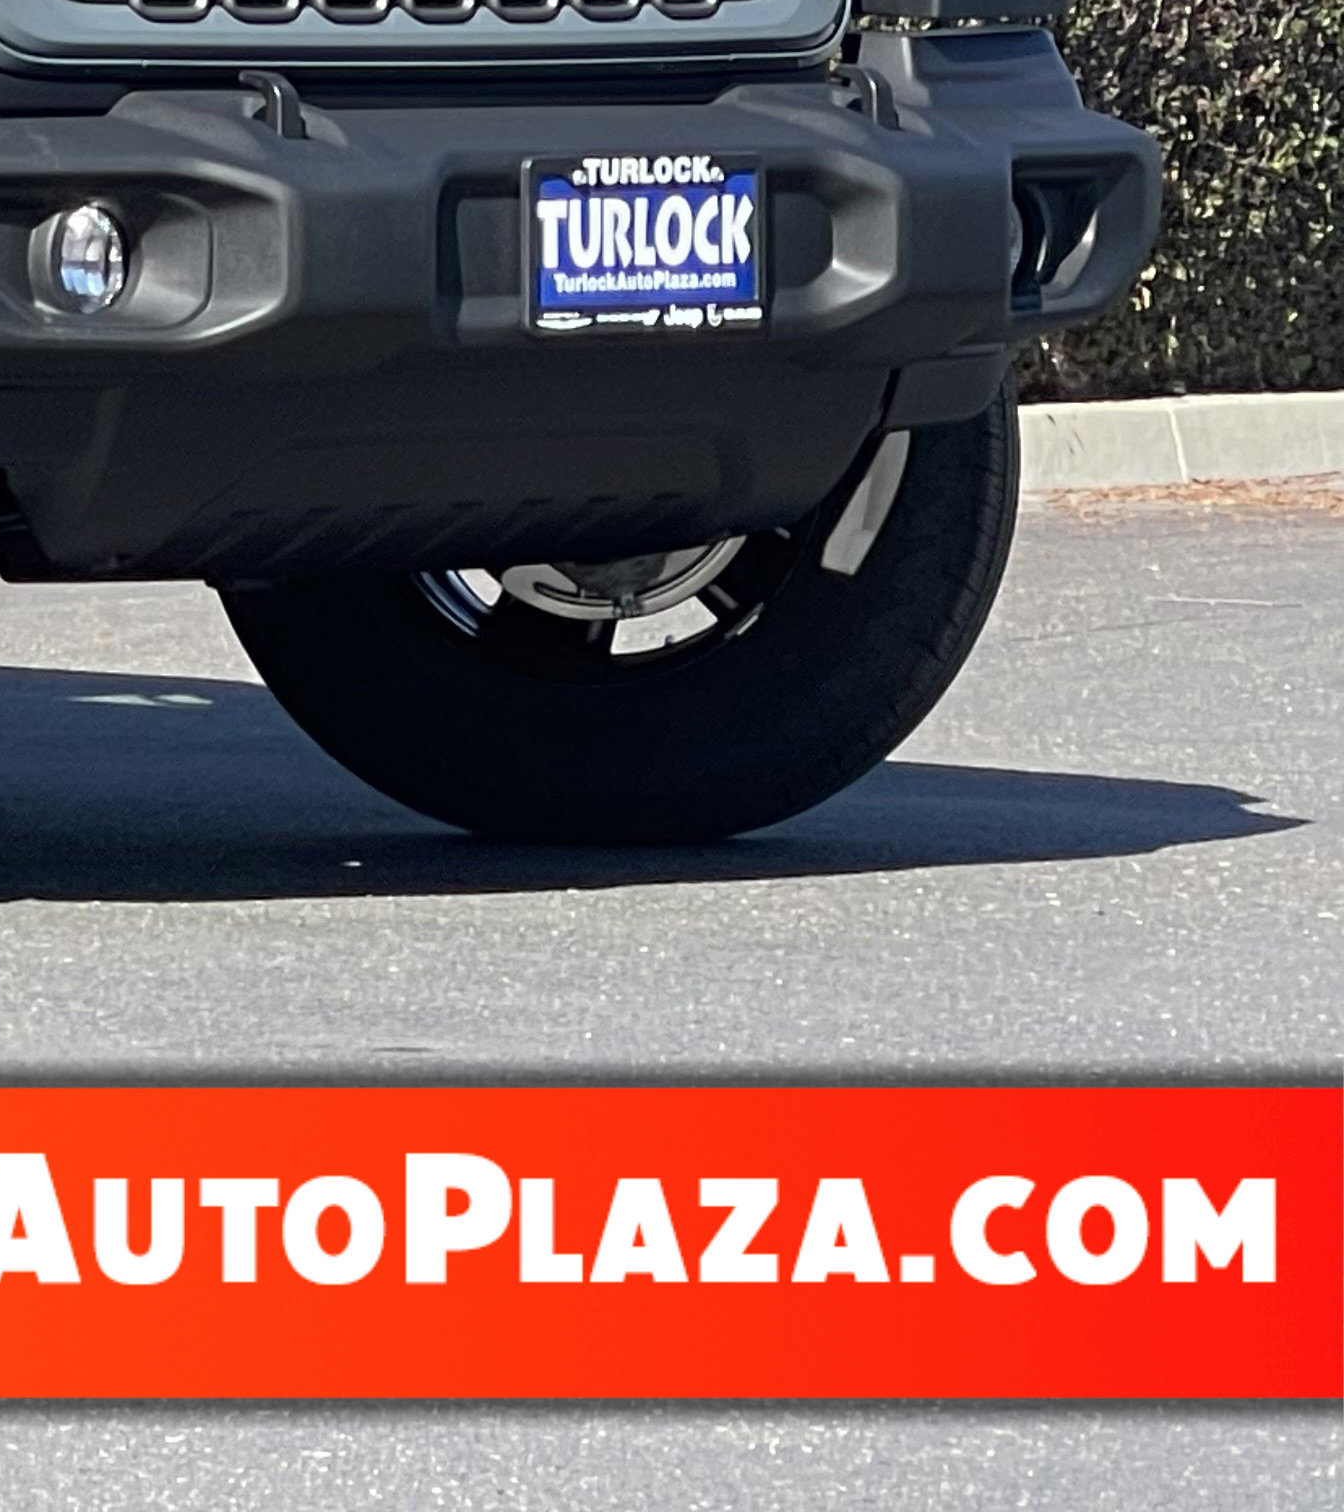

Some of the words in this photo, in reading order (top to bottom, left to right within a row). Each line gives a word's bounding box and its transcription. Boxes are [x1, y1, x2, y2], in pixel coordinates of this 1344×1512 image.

[582, 156, 711, 186] TURLOCK
[537, 194, 754, 269] TURLOCK
[554, 270, 737, 293] TurlockAutoPlaza.com
